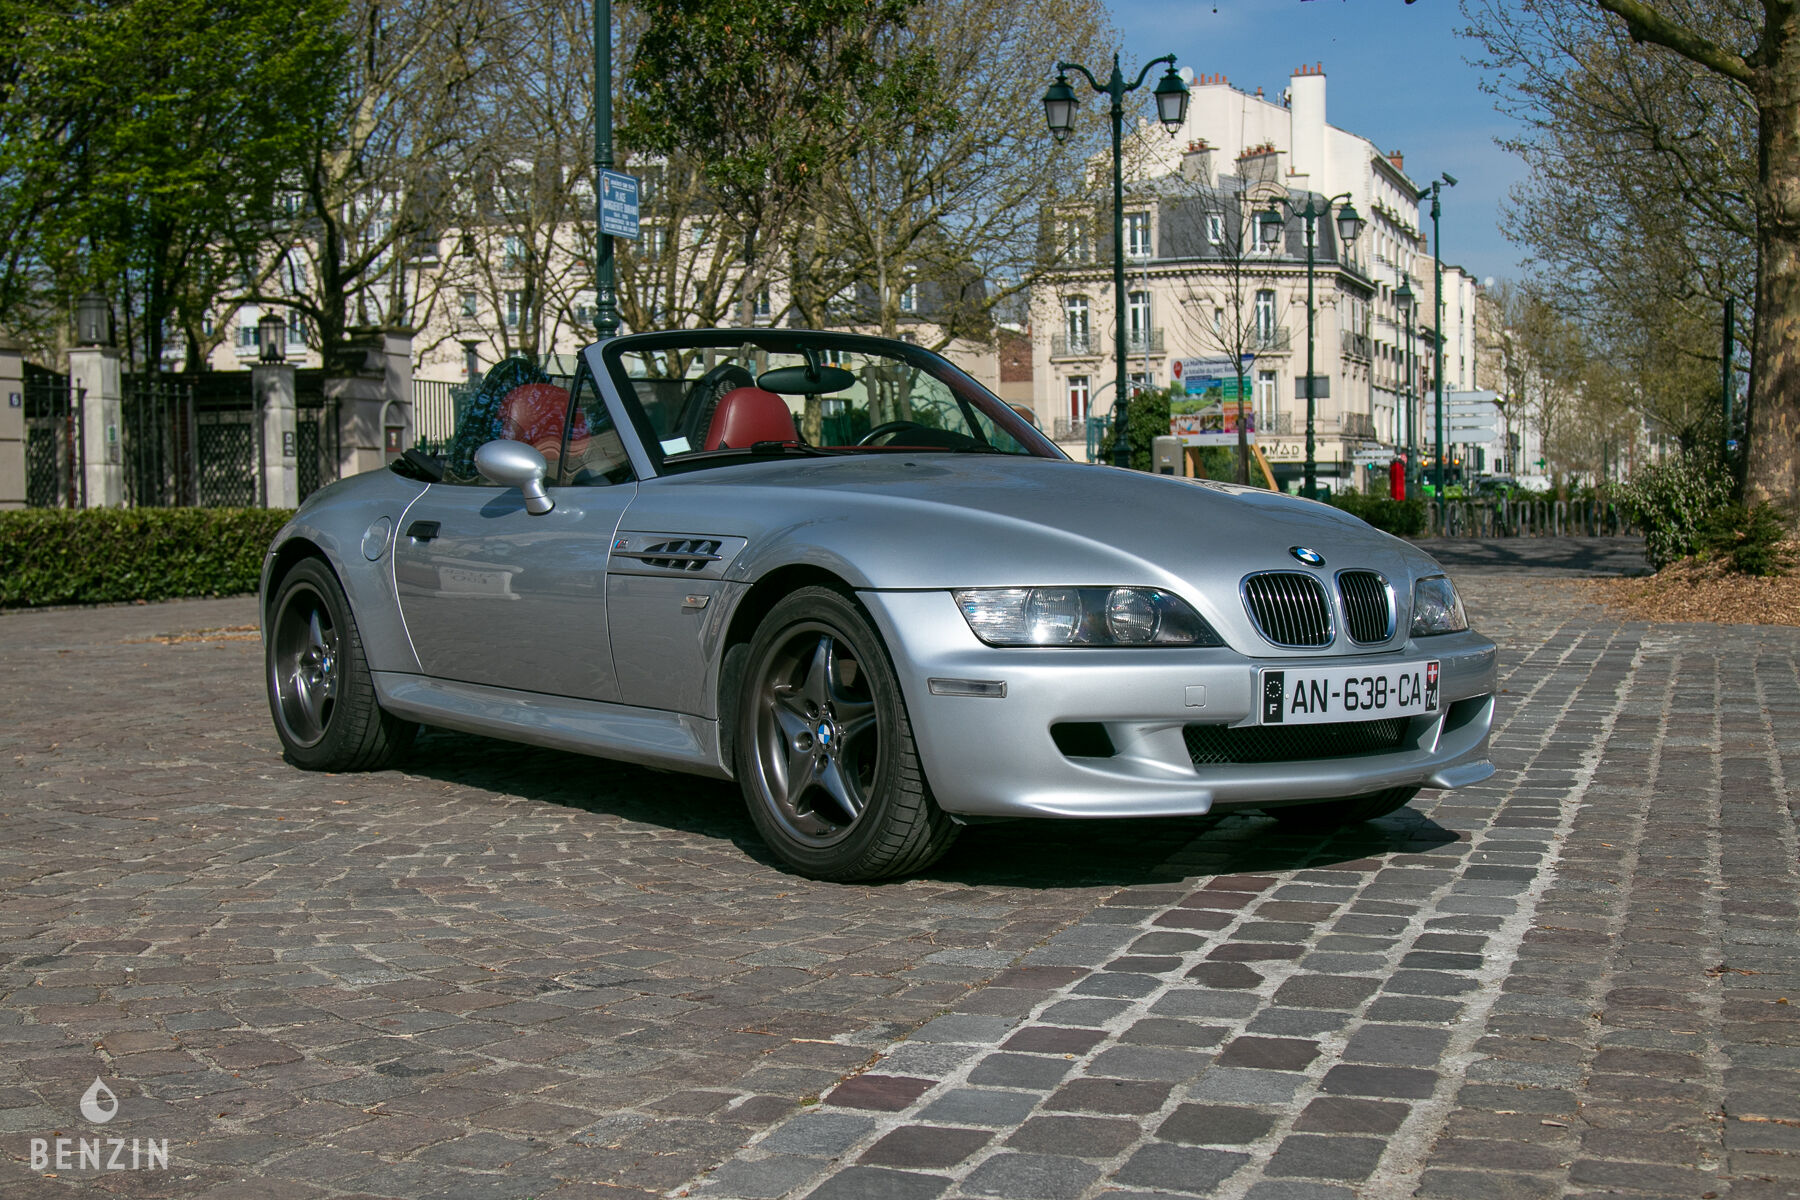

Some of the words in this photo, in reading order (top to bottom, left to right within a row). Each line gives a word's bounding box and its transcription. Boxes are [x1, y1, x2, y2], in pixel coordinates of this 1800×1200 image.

[1291, 672, 1421, 714] AN-638-CA
[1426, 689, 1437, 708] 74
[1269, 703, 1278, 715] F
